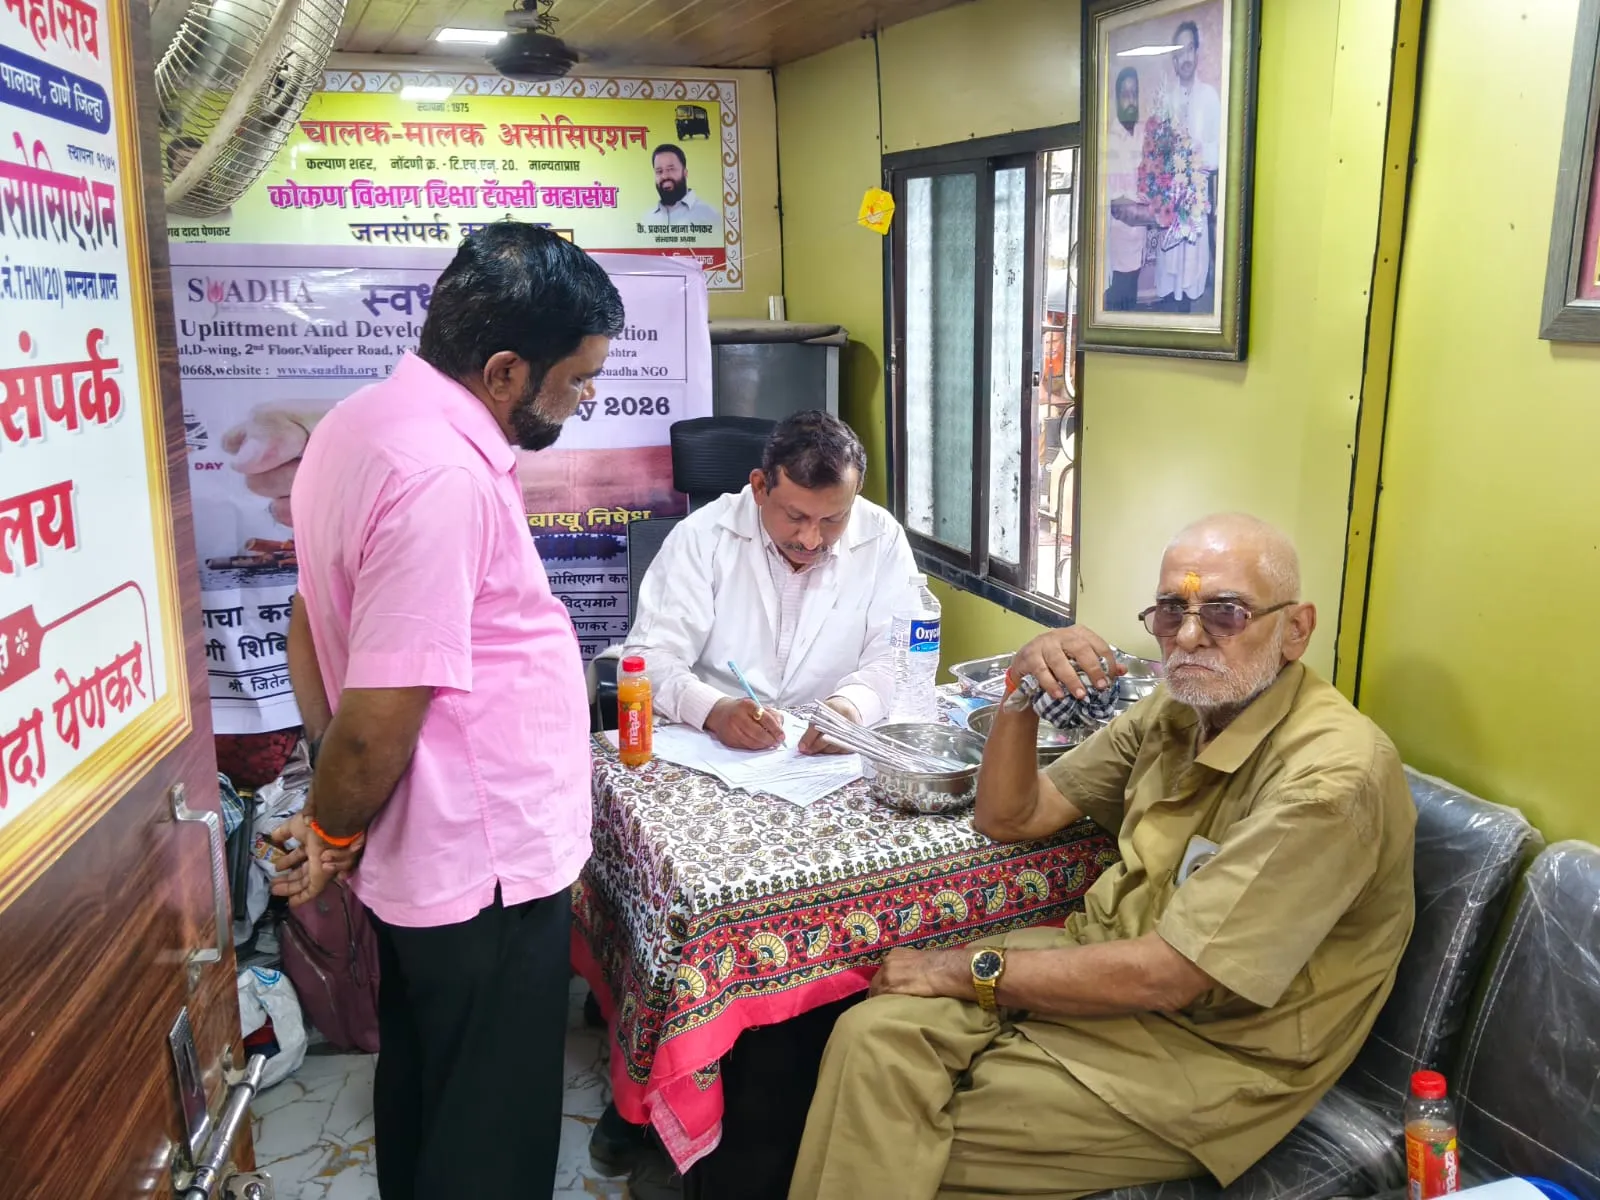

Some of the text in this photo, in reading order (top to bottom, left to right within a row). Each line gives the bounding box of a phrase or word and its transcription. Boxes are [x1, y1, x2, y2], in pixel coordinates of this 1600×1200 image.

[48, 76, 71, 109] ठाणे
[73, 82, 103, 123] जिल्हा
[451, 102, 469, 112] 1975
[498, 114, 650, 155] असोसिएशन
[67, 144, 94, 166] स्थापना
[306, 157, 346, 170] कल्याण
[349, 157, 377, 171] शहर,
[502, 159, 519, 171] 20.
[0, 131, 118, 251] सोसिएशन
[267, 179, 619, 208] कोकण विभाग रिक्षा टॅक्सी महासंघ
[181, 227, 200, 237] दादा
[201, 224, 231, 237] पेणकर
[348, 213, 450, 243] जनसंपर्क
[64, 270, 97, 300] मान्यता
[180, 319, 298, 341] Upliftment
[304, 320, 348, 337] And
[601, 366, 668, 378] Suadha NGO
[604, 397, 670, 416] 2026
[194, 462, 224, 470] DAY
[53, 641, 146, 750] पेणकर
[228, 678, 243, 692] श्री
